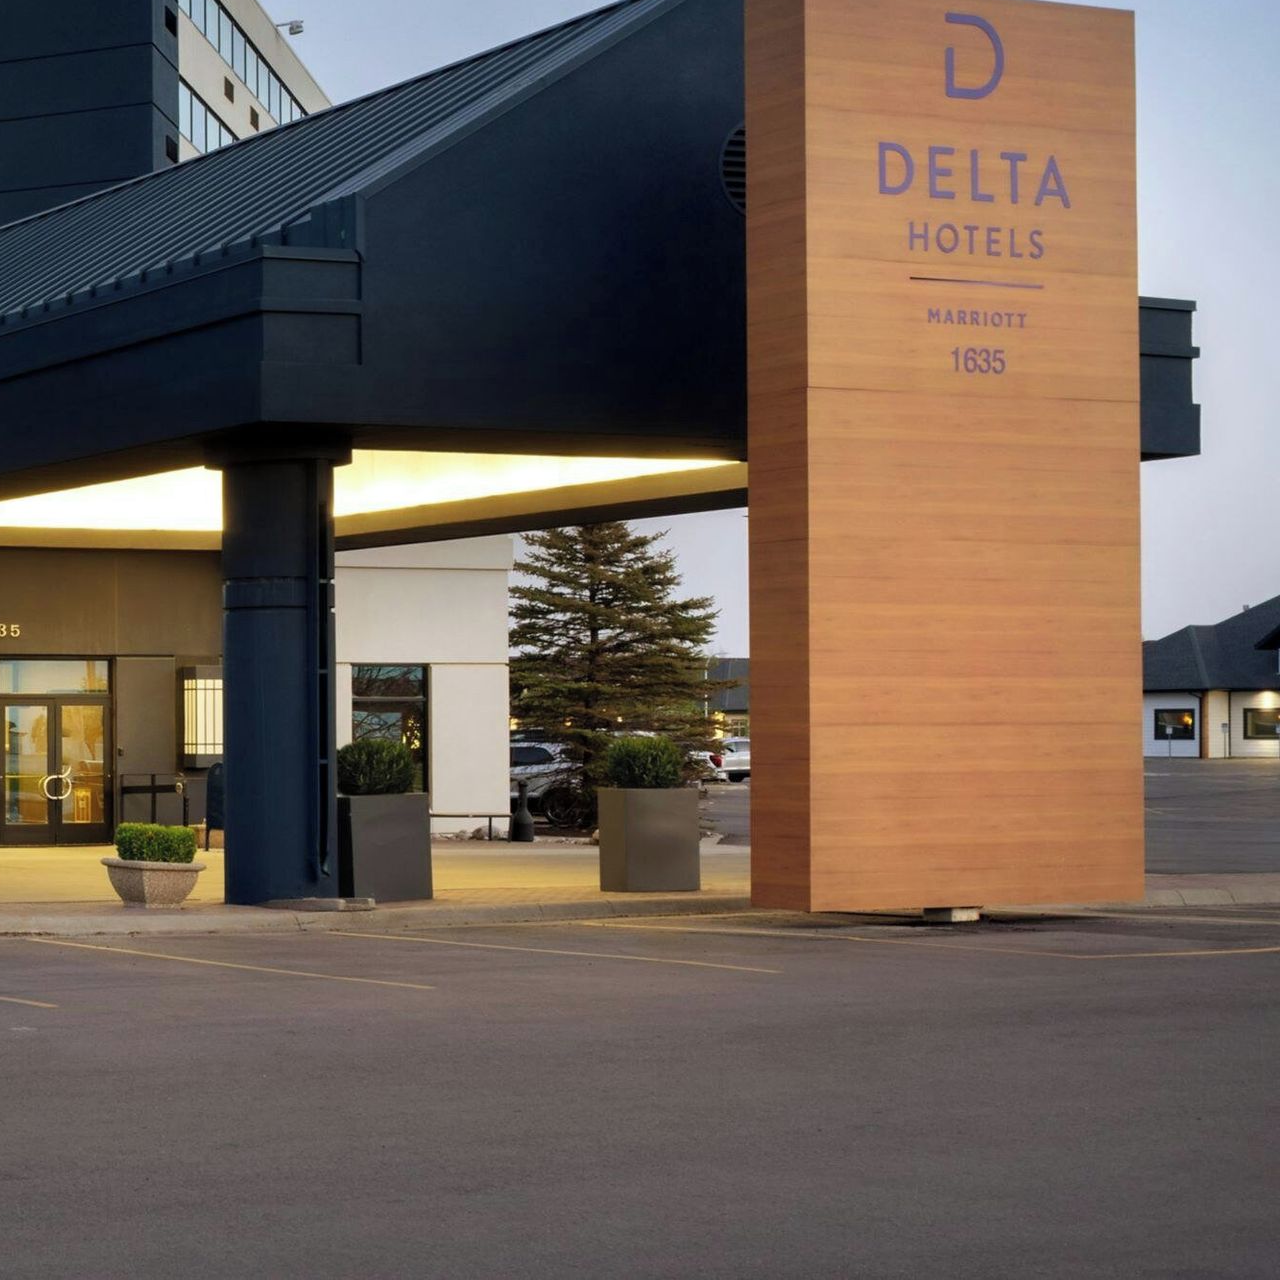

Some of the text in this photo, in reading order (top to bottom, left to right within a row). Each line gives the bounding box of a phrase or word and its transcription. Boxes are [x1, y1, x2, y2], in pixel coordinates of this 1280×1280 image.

[878, 142, 1071, 208] DELTA
[908, 221, 1046, 259] HOTELS
[927, 308, 1027, 329] MARRIOTT
[951, 347, 1007, 375] 1635
